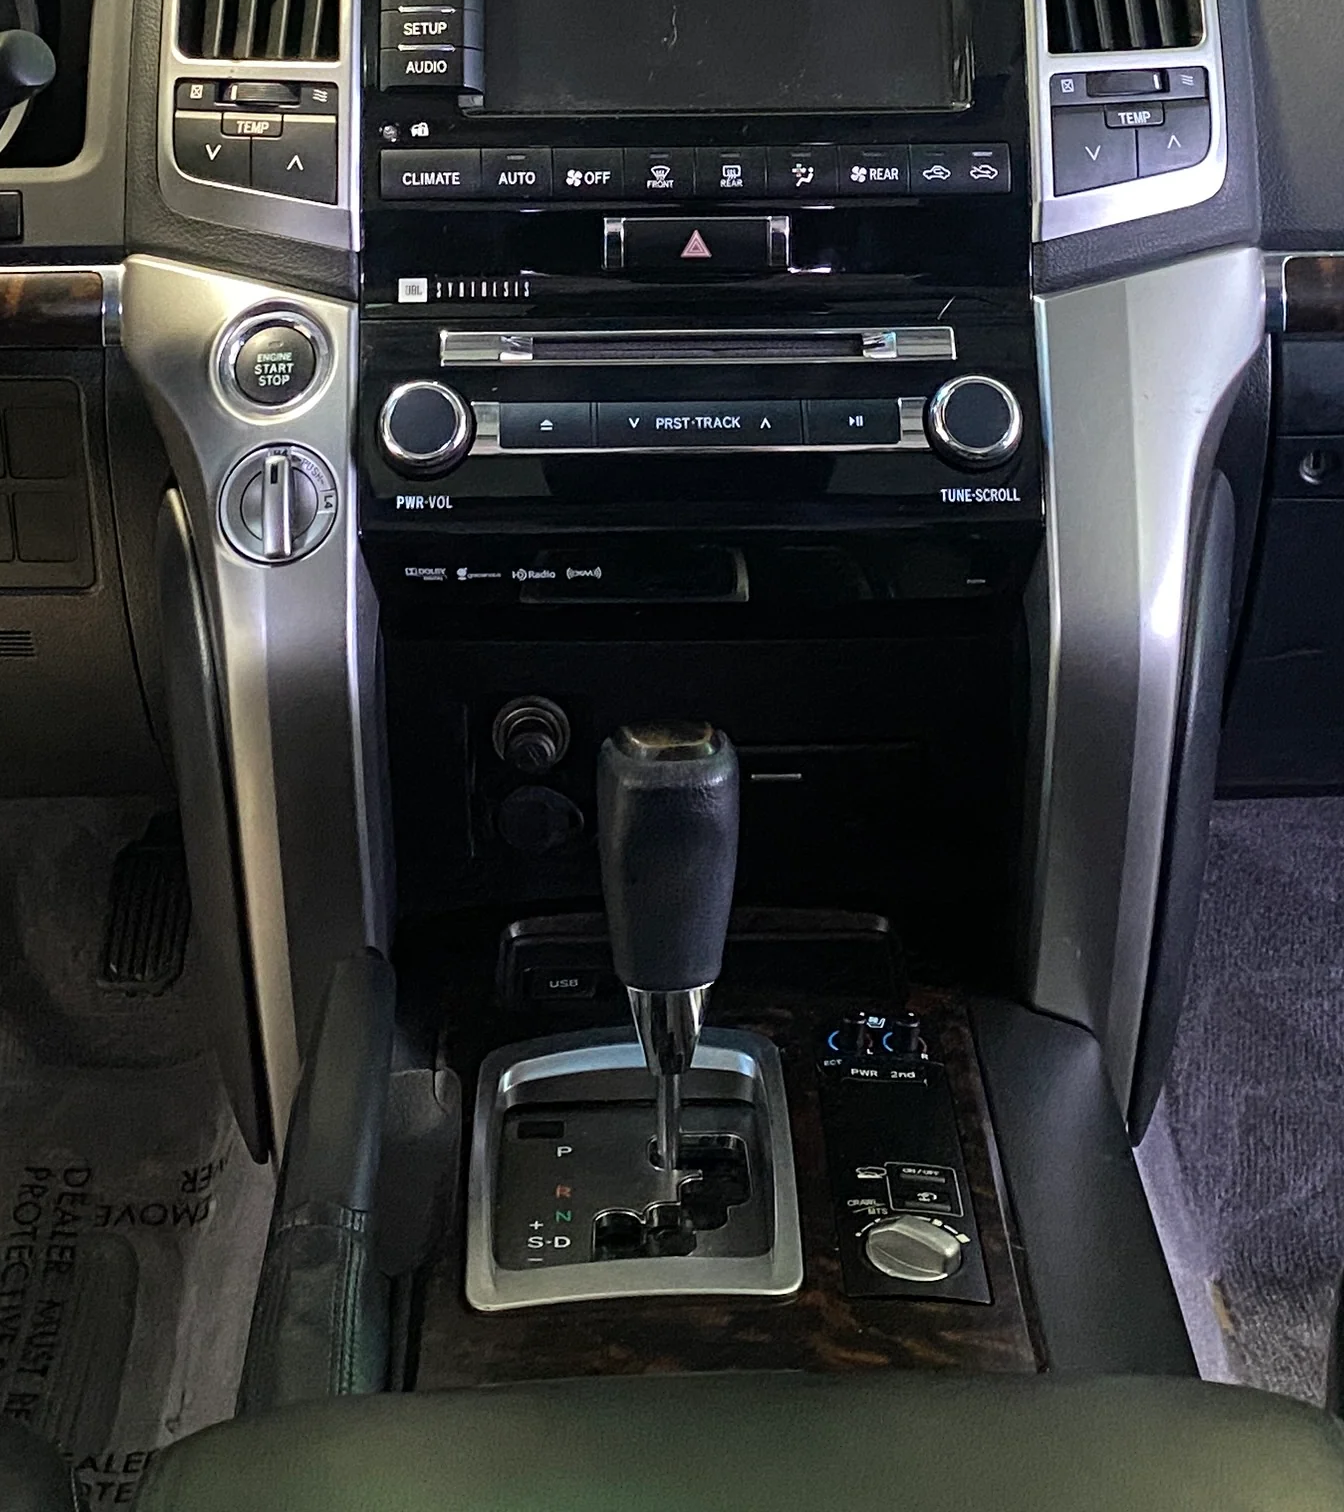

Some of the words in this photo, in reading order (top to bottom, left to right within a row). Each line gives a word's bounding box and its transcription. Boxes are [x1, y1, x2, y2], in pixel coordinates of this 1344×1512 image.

[403, 22, 447, 36] SETUP
[406, 60, 448, 74] AUDIO
[1118, 111, 1151, 125] TEMP
[236, 120, 270, 135] TEMP
[402, 171, 461, 186] CLIMATE
[498, 171, 536, 185] AUTO
[584, 171, 611, 185] OFF
[869, 167, 899, 181] REAR
[646, 179, 674, 189] FRONT
[720, 177, 743, 188] REAR
[257, 352, 293, 362] ENGINE
[254, 362, 294, 375] START
[259, 374, 290, 386] STOP
[301, 458, 324, 482] PUSH
[324, 495, 333, 509] L4
[528, 570, 556, 579] Radio
[549, 978, 579, 989] USB
[850, 1068, 879, 1078] PWR
[890, 1069, 916, 1079] 2nd
[556, 1145, 573, 1158] P
[556, 1186, 571, 1198] R
[556, 1210, 572, 1222] N
[43, 1166, 92, 1285] DEALER
[21, 1298, 63, 1379] MUST
